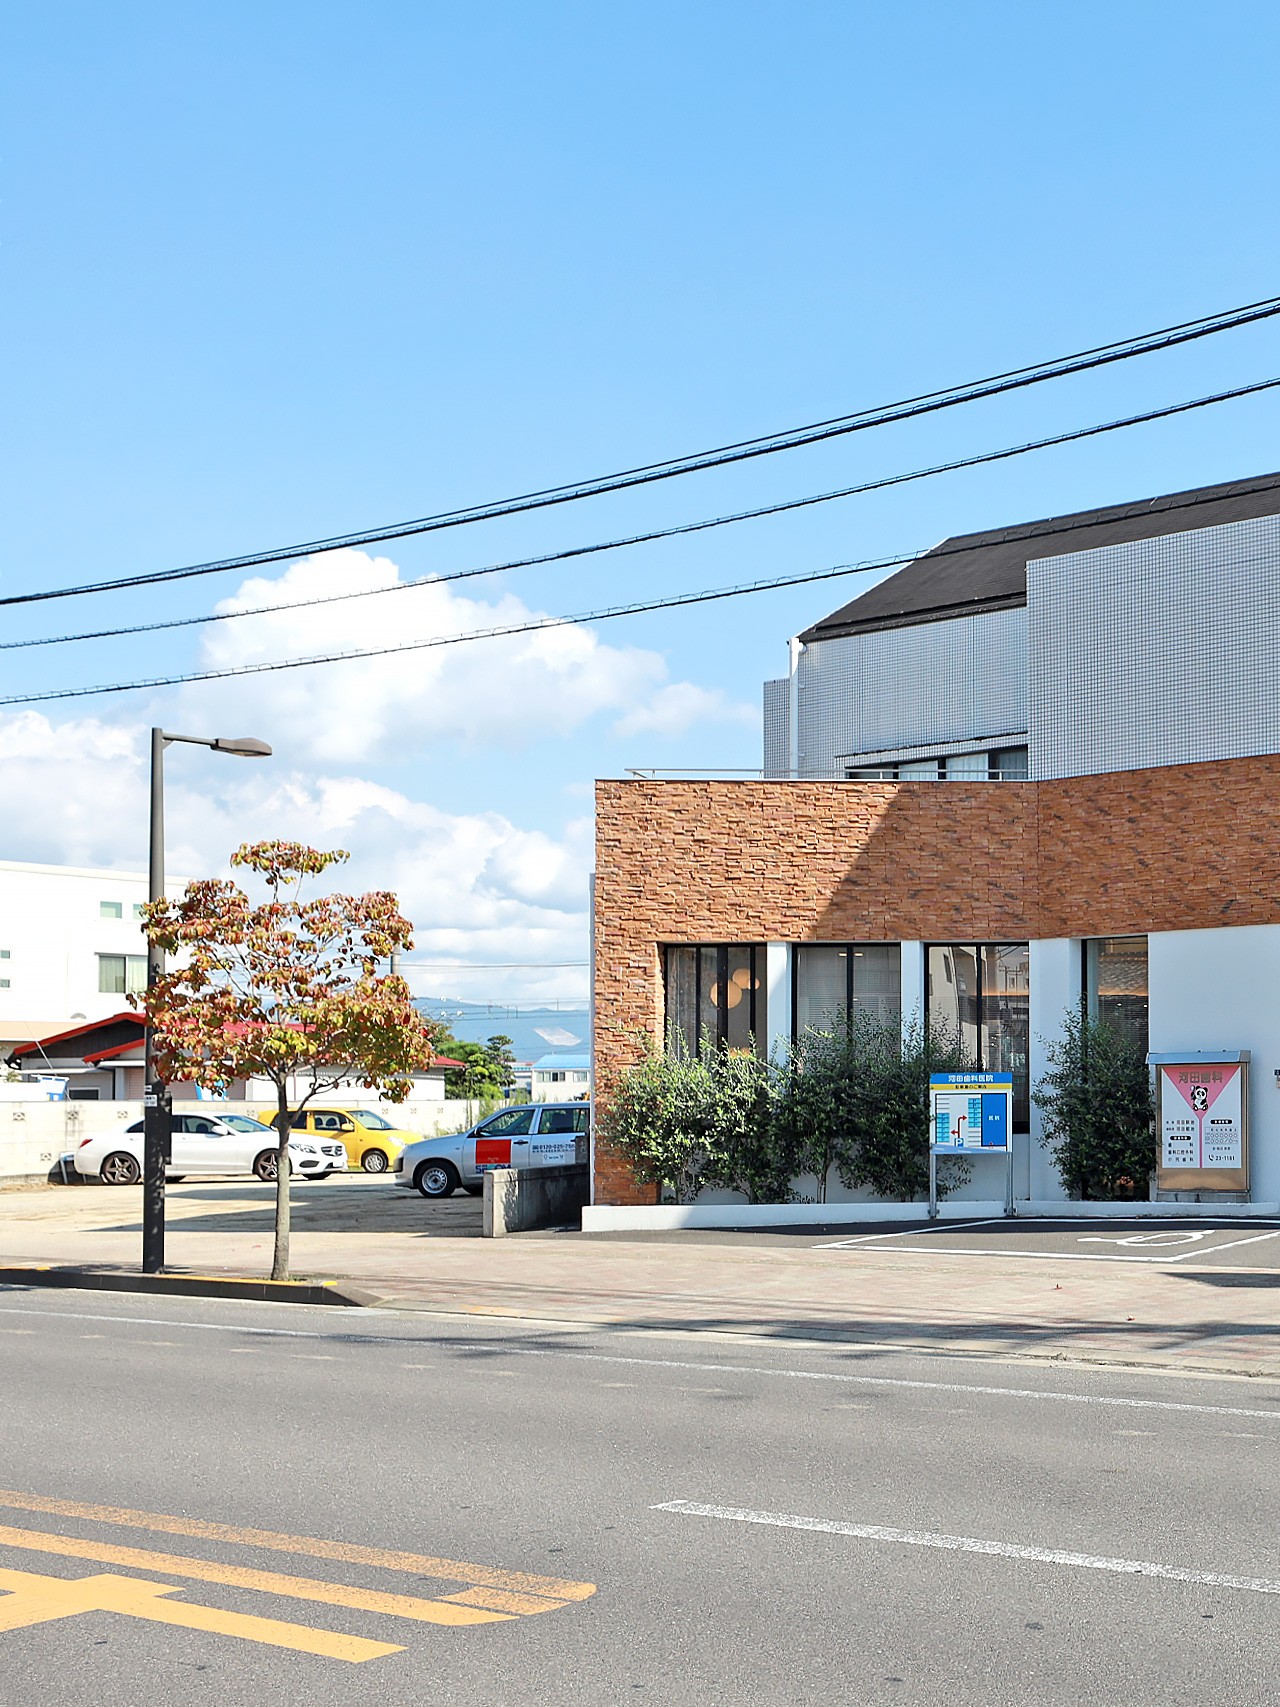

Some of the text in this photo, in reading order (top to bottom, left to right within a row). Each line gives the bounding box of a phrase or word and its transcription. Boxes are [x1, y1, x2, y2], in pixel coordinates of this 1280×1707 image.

[948, 1074, 994, 1083] 河田歯科医院
[1178, 1071, 1223, 1083] 河田歯科
[955, 1138, 962, 1146] P
